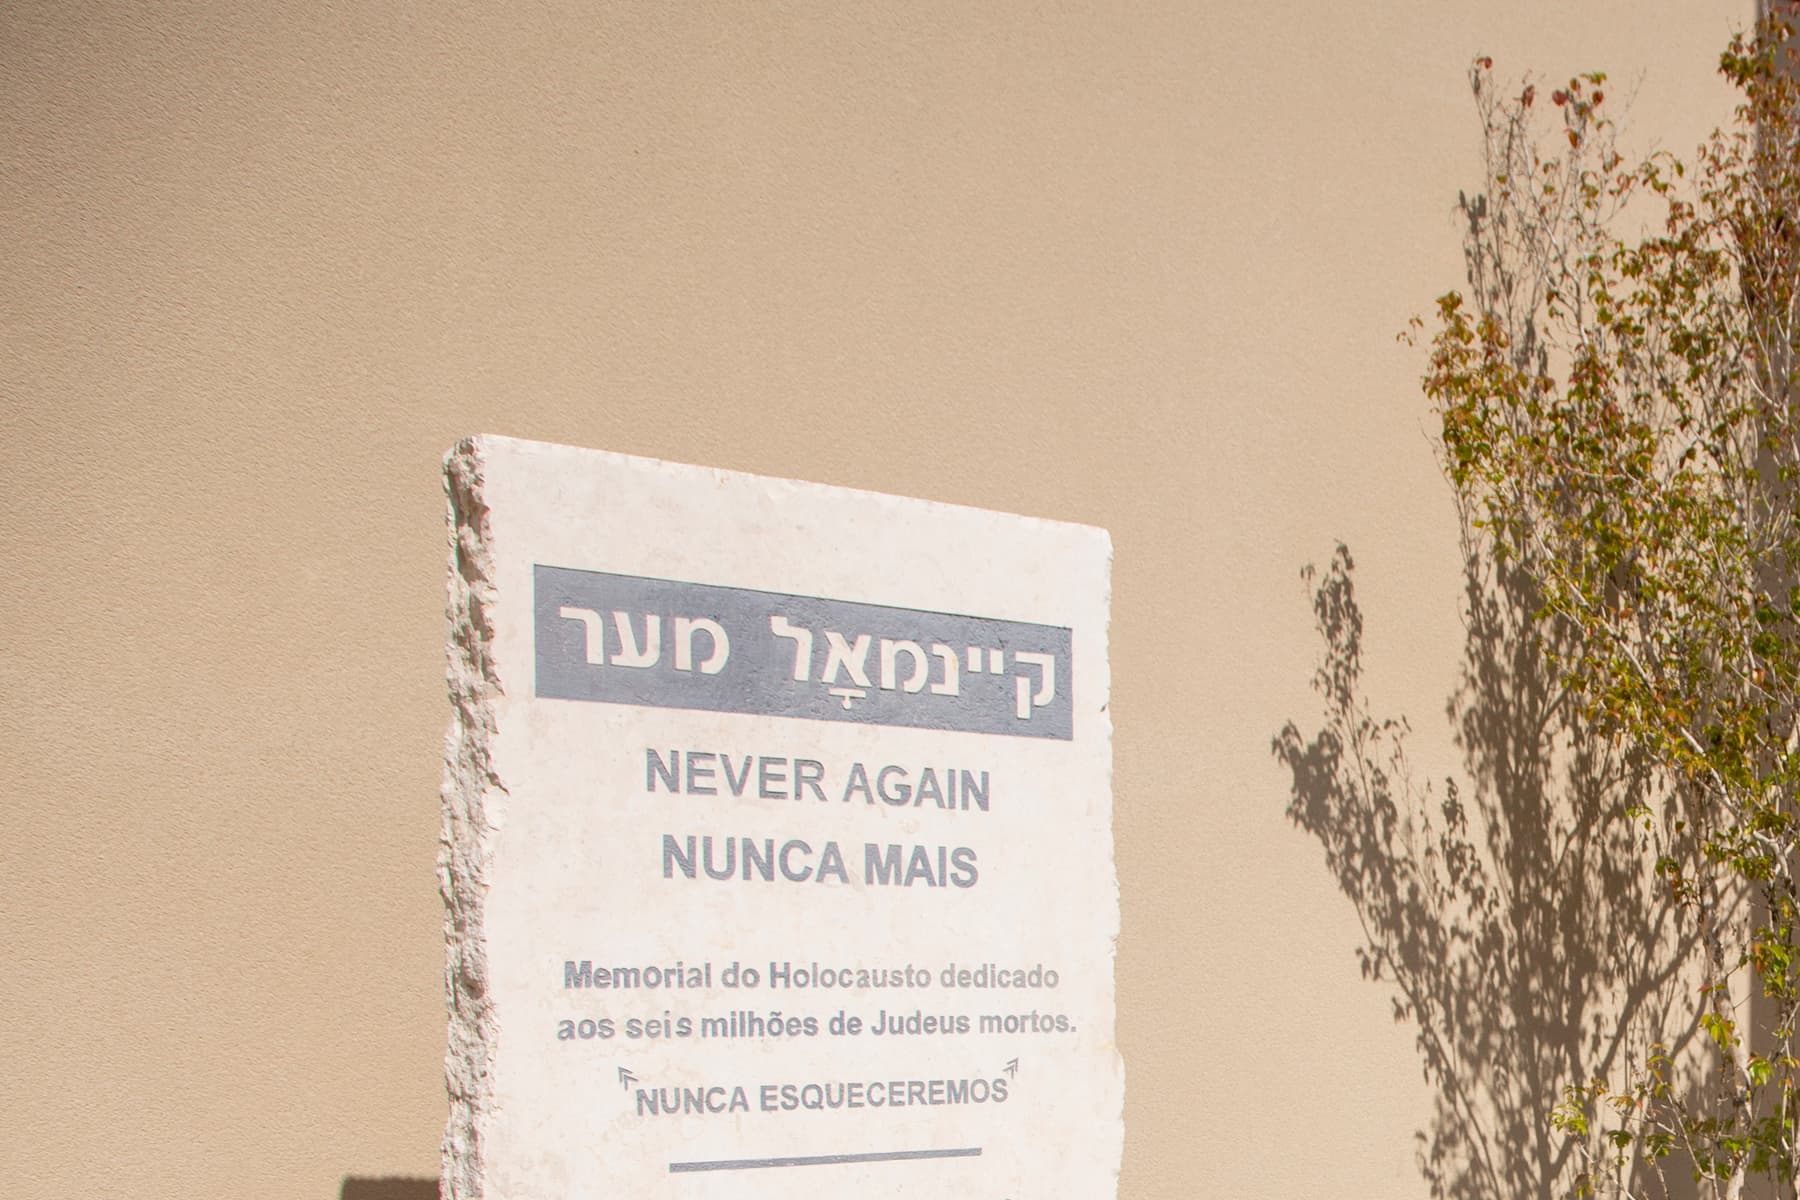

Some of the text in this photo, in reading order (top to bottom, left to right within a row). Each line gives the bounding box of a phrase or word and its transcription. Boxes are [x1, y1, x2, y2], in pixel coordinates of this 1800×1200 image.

[559, 605, 730, 675] מער
[645, 747, 990, 813] NEVER AGAIN
[662, 833, 979, 889] NUNCA MAIS
[563, 960, 1060, 990] Memorial do Holocausto dedicado
[556, 1009, 1077, 1042] aos seis milhões de Judeus mortos.
[635, 1077, 1009, 1117] NUNCA ESQUECEREMOS
